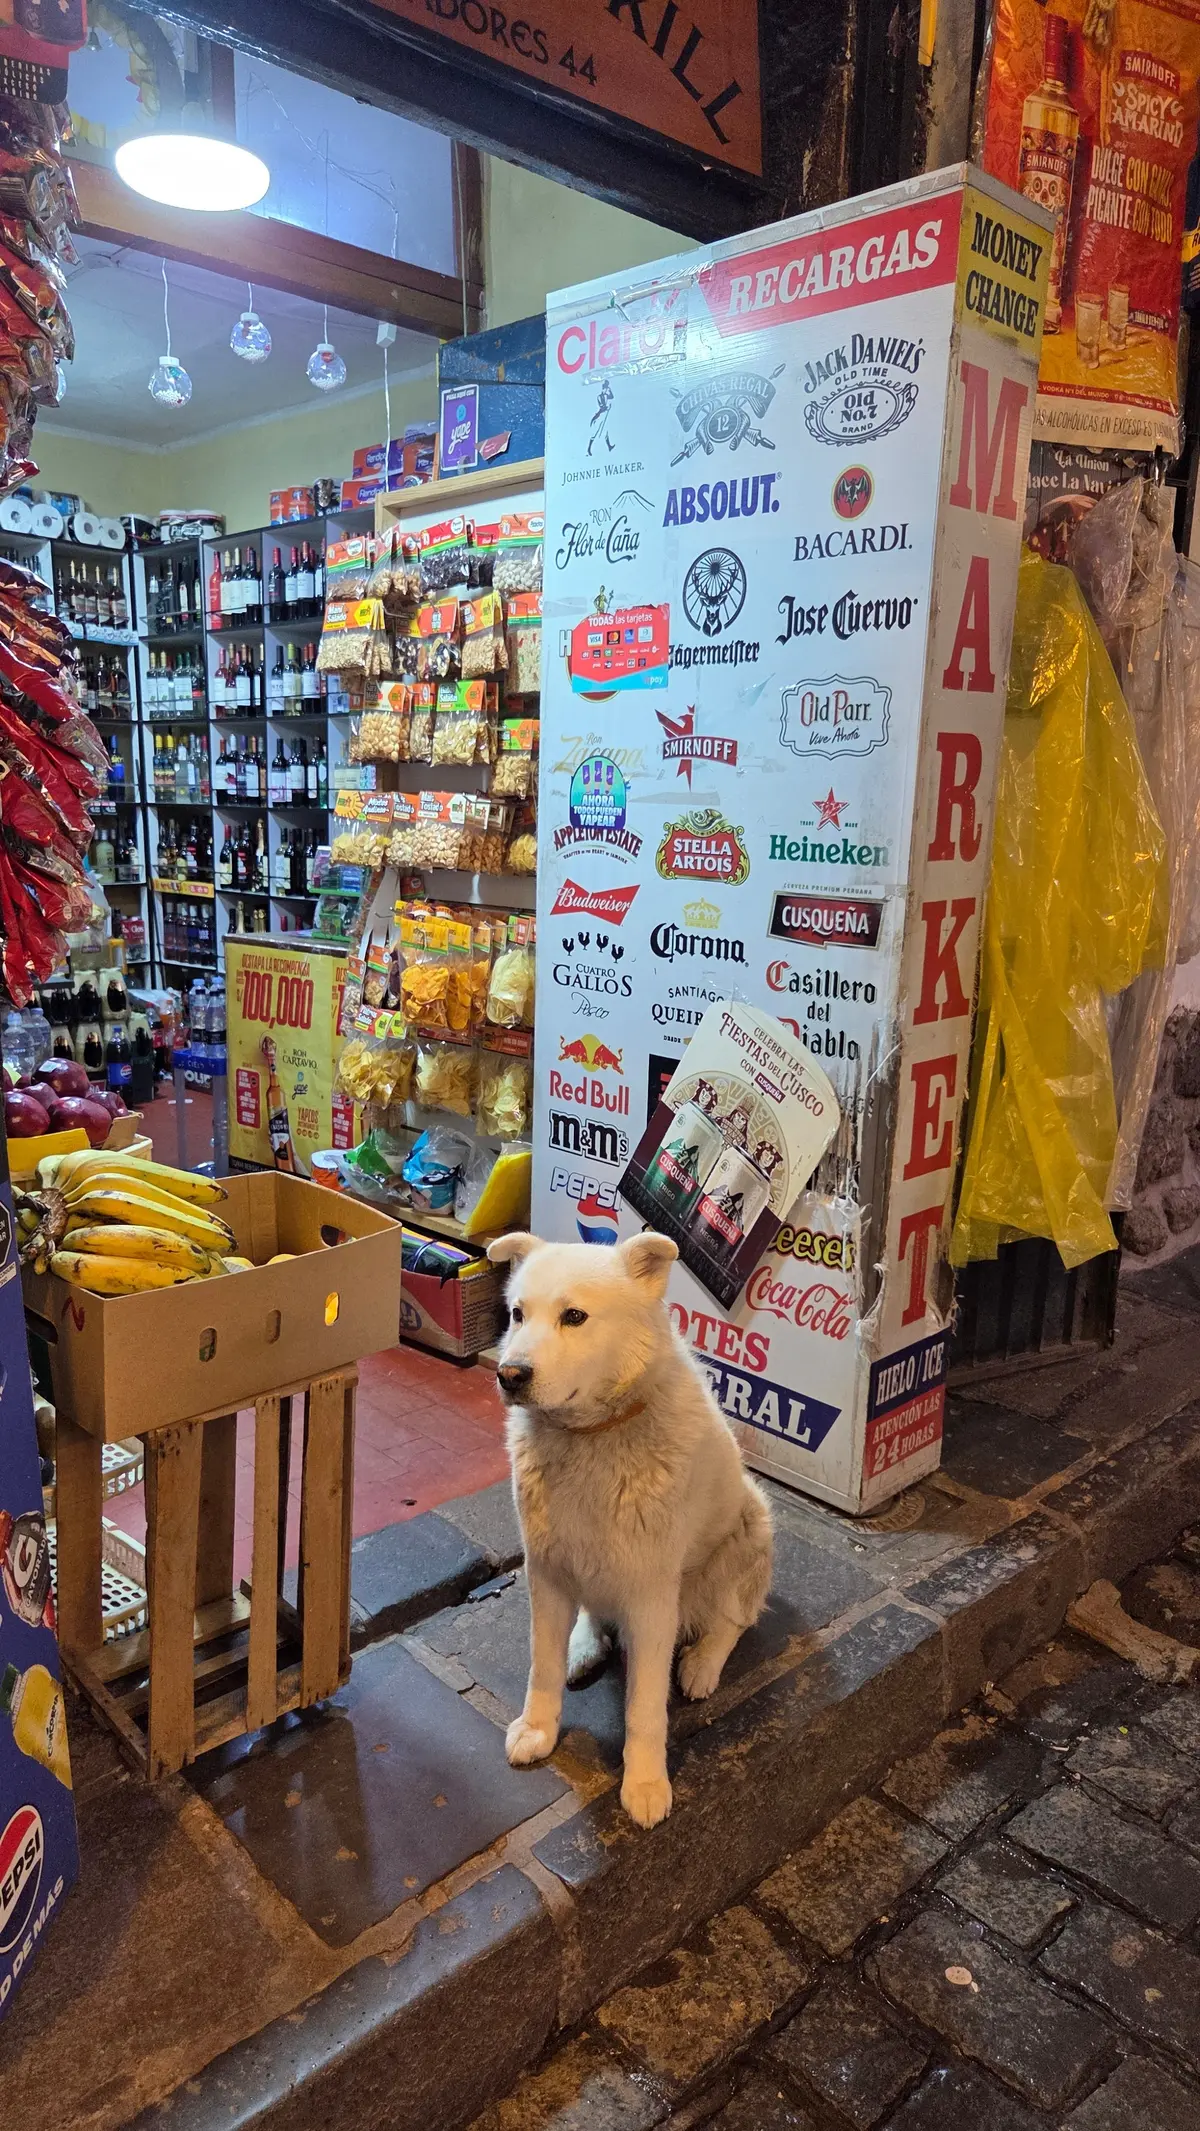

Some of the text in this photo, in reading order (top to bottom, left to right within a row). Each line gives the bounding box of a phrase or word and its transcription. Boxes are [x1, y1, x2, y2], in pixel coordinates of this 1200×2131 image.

[558, 44, 598, 88] 44
[1125, 55, 1177, 90] SMIRNOFF
[1126, 82, 1171, 121] SPICY
[1026, 152, 1069, 174] SMIRNOFF
[1126, 155, 1150, 195] CON
[1085, 183, 1132, 230] PICANTE
[970, 211, 1043, 282] MONEY
[726, 219, 943, 318] RECARGAS
[965, 272, 1040, 338] CHANGE
[803, 333, 927, 394] JACK DANIEL'S
[834, 366, 889, 386] OLD TIME
[730, 375, 770, 399] REGAL
[843, 389, 876, 410] Old
[1042, 384, 1064, 394] VODKA
[1075, 388, 1087, 397] DEL
[1087, 390, 1110, 400] MUNDO
[447, 420, 472, 455] yape
[716, 413, 731, 433] 12
[841, 422, 874, 434] BRAND
[1047, 410, 1098, 433] ALCOHÓLICAS
[1100, 417, 1110, 434] EN
[1112, 416, 1141, 437] EXCESO
[1054, 449, 1072, 467] La
[561, 468, 601, 487] JOHNNIE
[1062, 472, 1080, 490] La
[589, 507, 613, 527] RON
[555, 514, 641, 570] Flor de Caña
[588, 613, 653, 627] TODAS las tarjetas
[775, 589, 914, 646] Jose Cuervo
[801, 691, 830, 727] Old
[586, 732, 603, 745] Ron
[664, 739, 733, 762] SMIRNOFF
[809, 726, 861, 746] Vive Ahora
[420, 801, 444, 813] Tostado
[573, 806, 623, 817] TODOS PUEDEN
[581, 795, 615, 807] AHORA
[580, 814, 616, 827] YAPEAR
[605, 828, 643, 859] ESTATE
[673, 838, 733, 857] STELLA
[769, 834, 890, 867] Heineken
[671, 855, 733, 874] ARTOIS
[557, 887, 631, 913] Budweiser
[783, 882, 873, 896] CERVEZA PREMIUM PERUANA
[781, 904, 870, 936] CUSQUEÑA
[650, 922, 746, 964] Corona
[265, 957, 273, 972] LA
[552, 961, 633, 998] GALLOS
[575, 963, 616, 979] CUATRO
[765, 959, 877, 1004] Casillero
[241, 969, 315, 1030] 100,000
[571, 991, 610, 1020] Pisco
[807, 1000, 830, 1022] del
[292, 1048, 307, 1058] RON
[719, 1011, 824, 1117] FIESTAS DEL CUSCO
[753, 1026, 806, 1077] CELEBRA LAS
[549, 1070, 630, 1115] Red Bull
[740, 1058, 783, 1101] CON CUSQUEÑA
[550, 1166, 621, 1212] PEPSI
[659, 1153, 693, 1194] CUSQUEÑA
[659, 1181, 676, 1201] TRIGO
[702, 1200, 737, 1242] CUSQUEÑA
[700, 1227, 719, 1251] NEGRA
[875, 1359, 915, 1406] HIELO
[922, 1342, 945, 1384] ICE
[872, 1392, 941, 1445] ATENCIÓN LAS
[872, 1422, 935, 1475] 24 HORAS
[0, 1827, 41, 1911] EPSI
[13, 1932, 33, 1979] DE
[33, 1875, 65, 1939] MÁS
